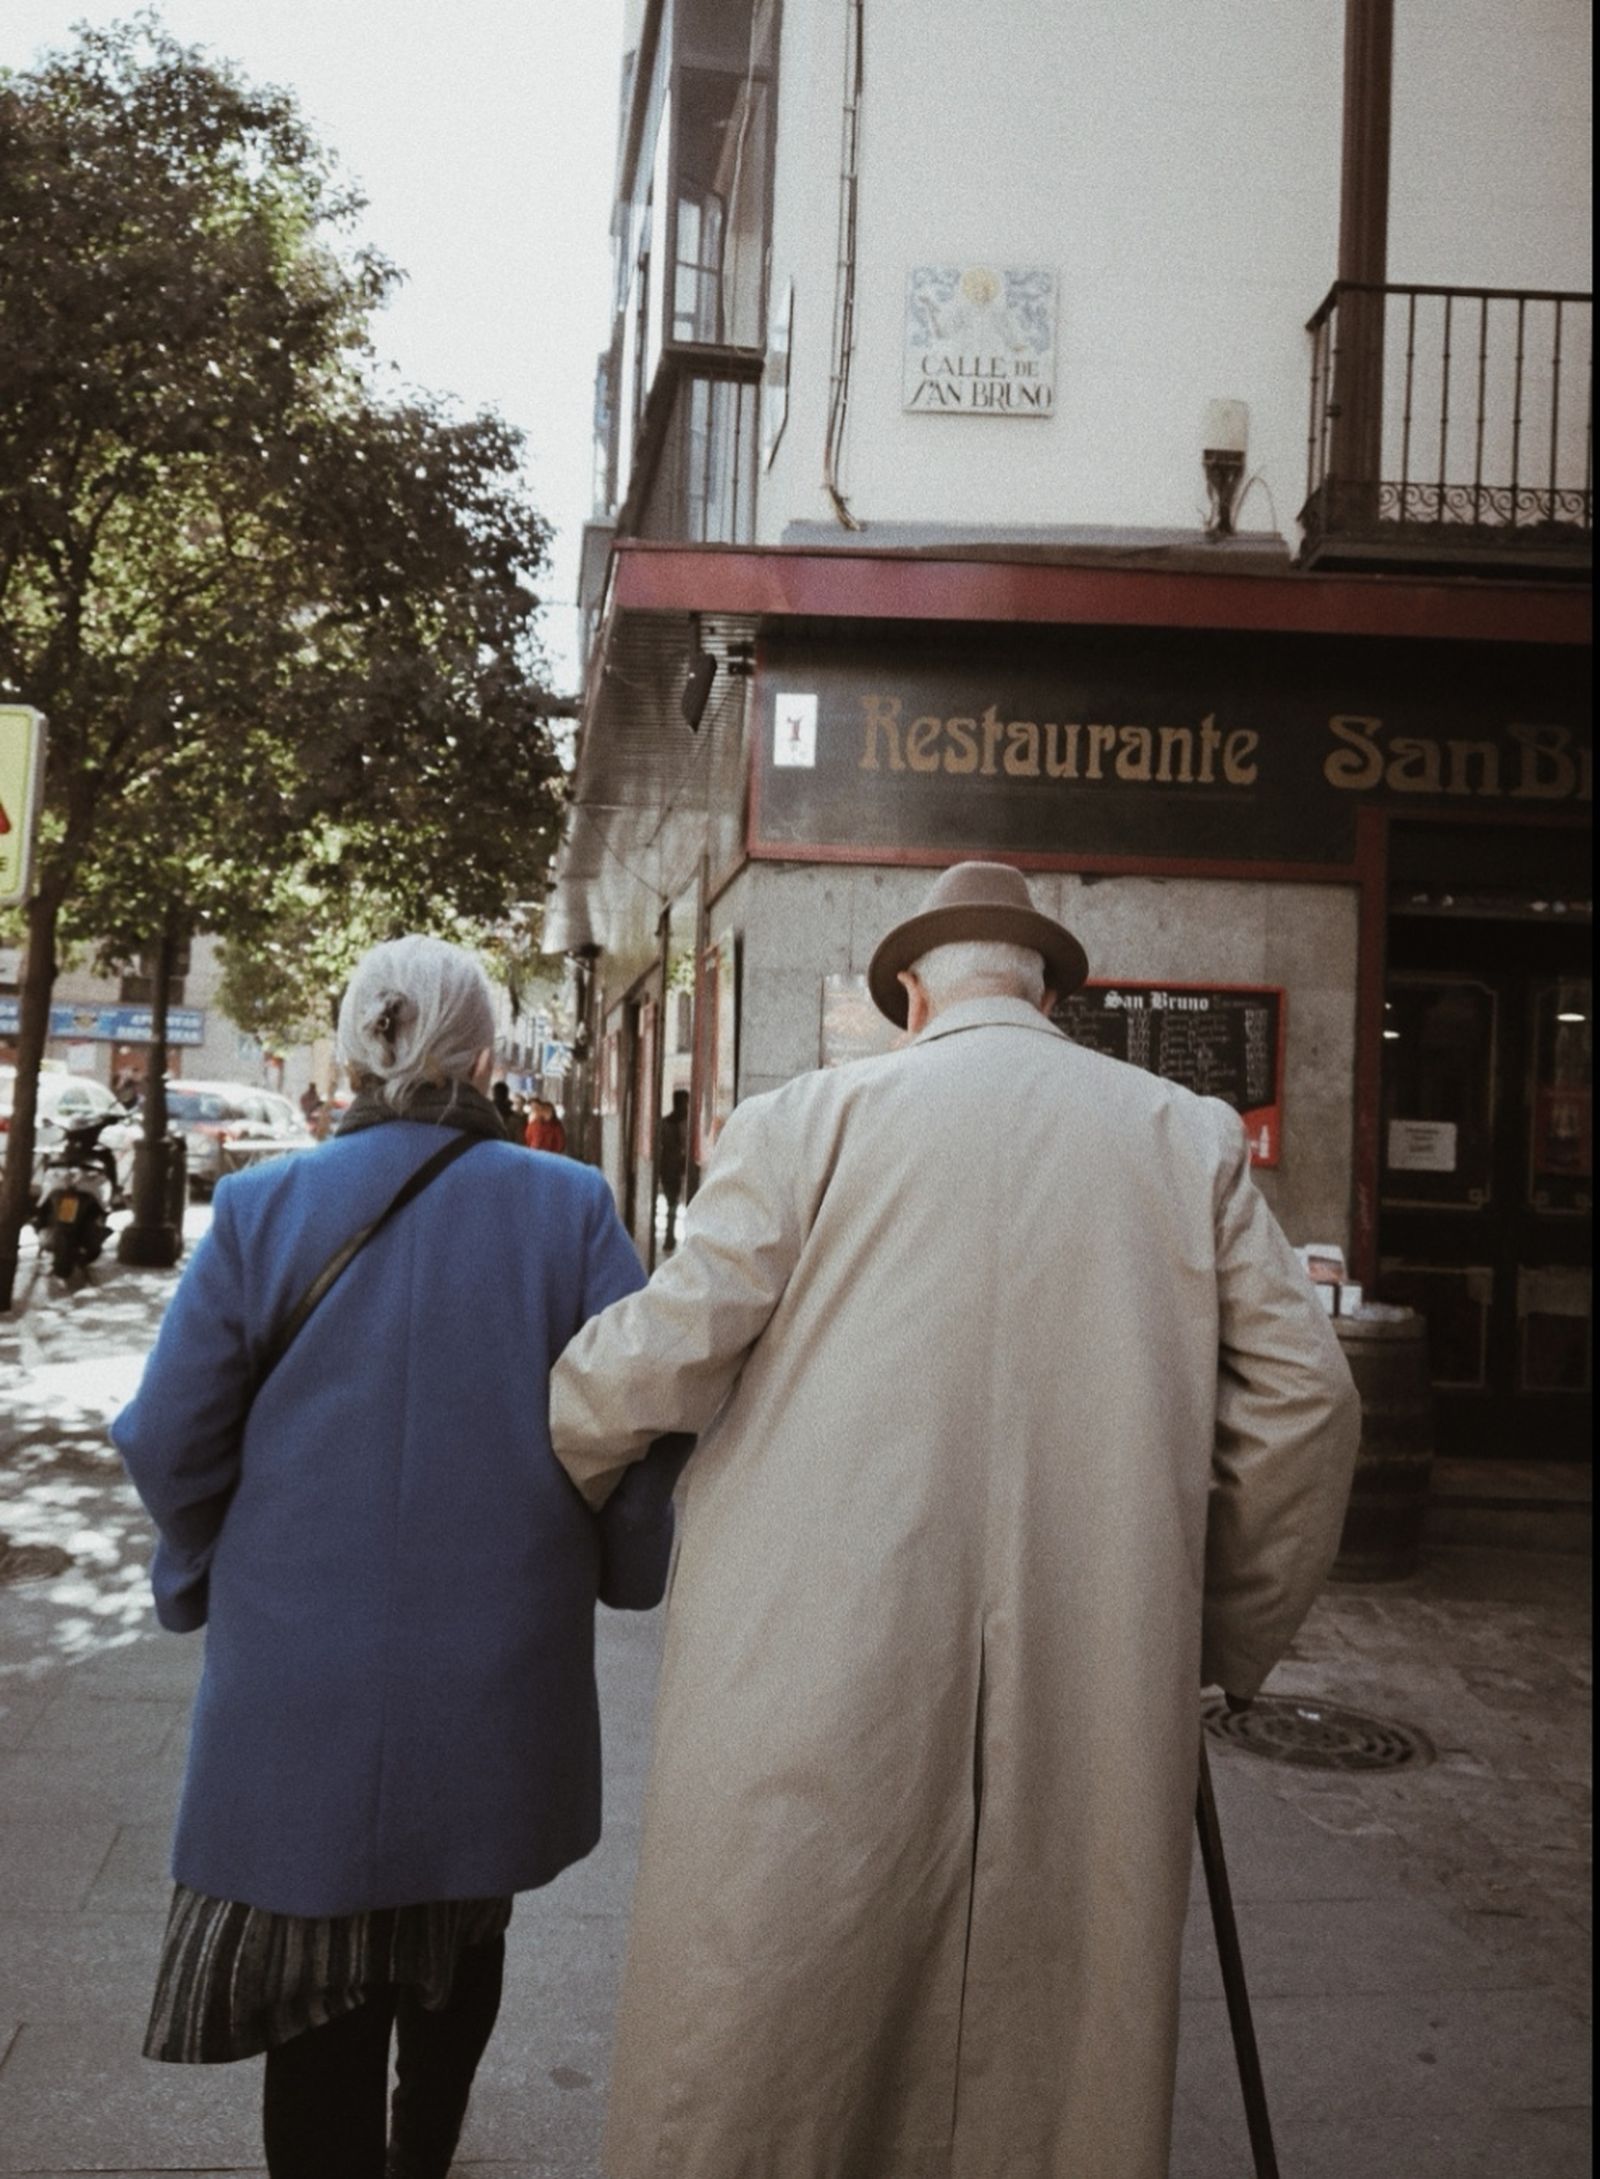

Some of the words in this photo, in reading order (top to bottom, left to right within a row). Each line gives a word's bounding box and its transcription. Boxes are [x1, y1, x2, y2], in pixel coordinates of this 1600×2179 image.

[921, 355, 1007, 379] CALLE
[1014, 361, 1039, 378] DE
[910, 379, 961, 406] SAN
[972, 381, 1053, 410] BRUNO
[858, 693, 1260, 786] Restaurante
[1322, 713, 1502, 797] San
[1103, 989, 1144, 1010] San
[1151, 991, 1209, 1011] Bruno
